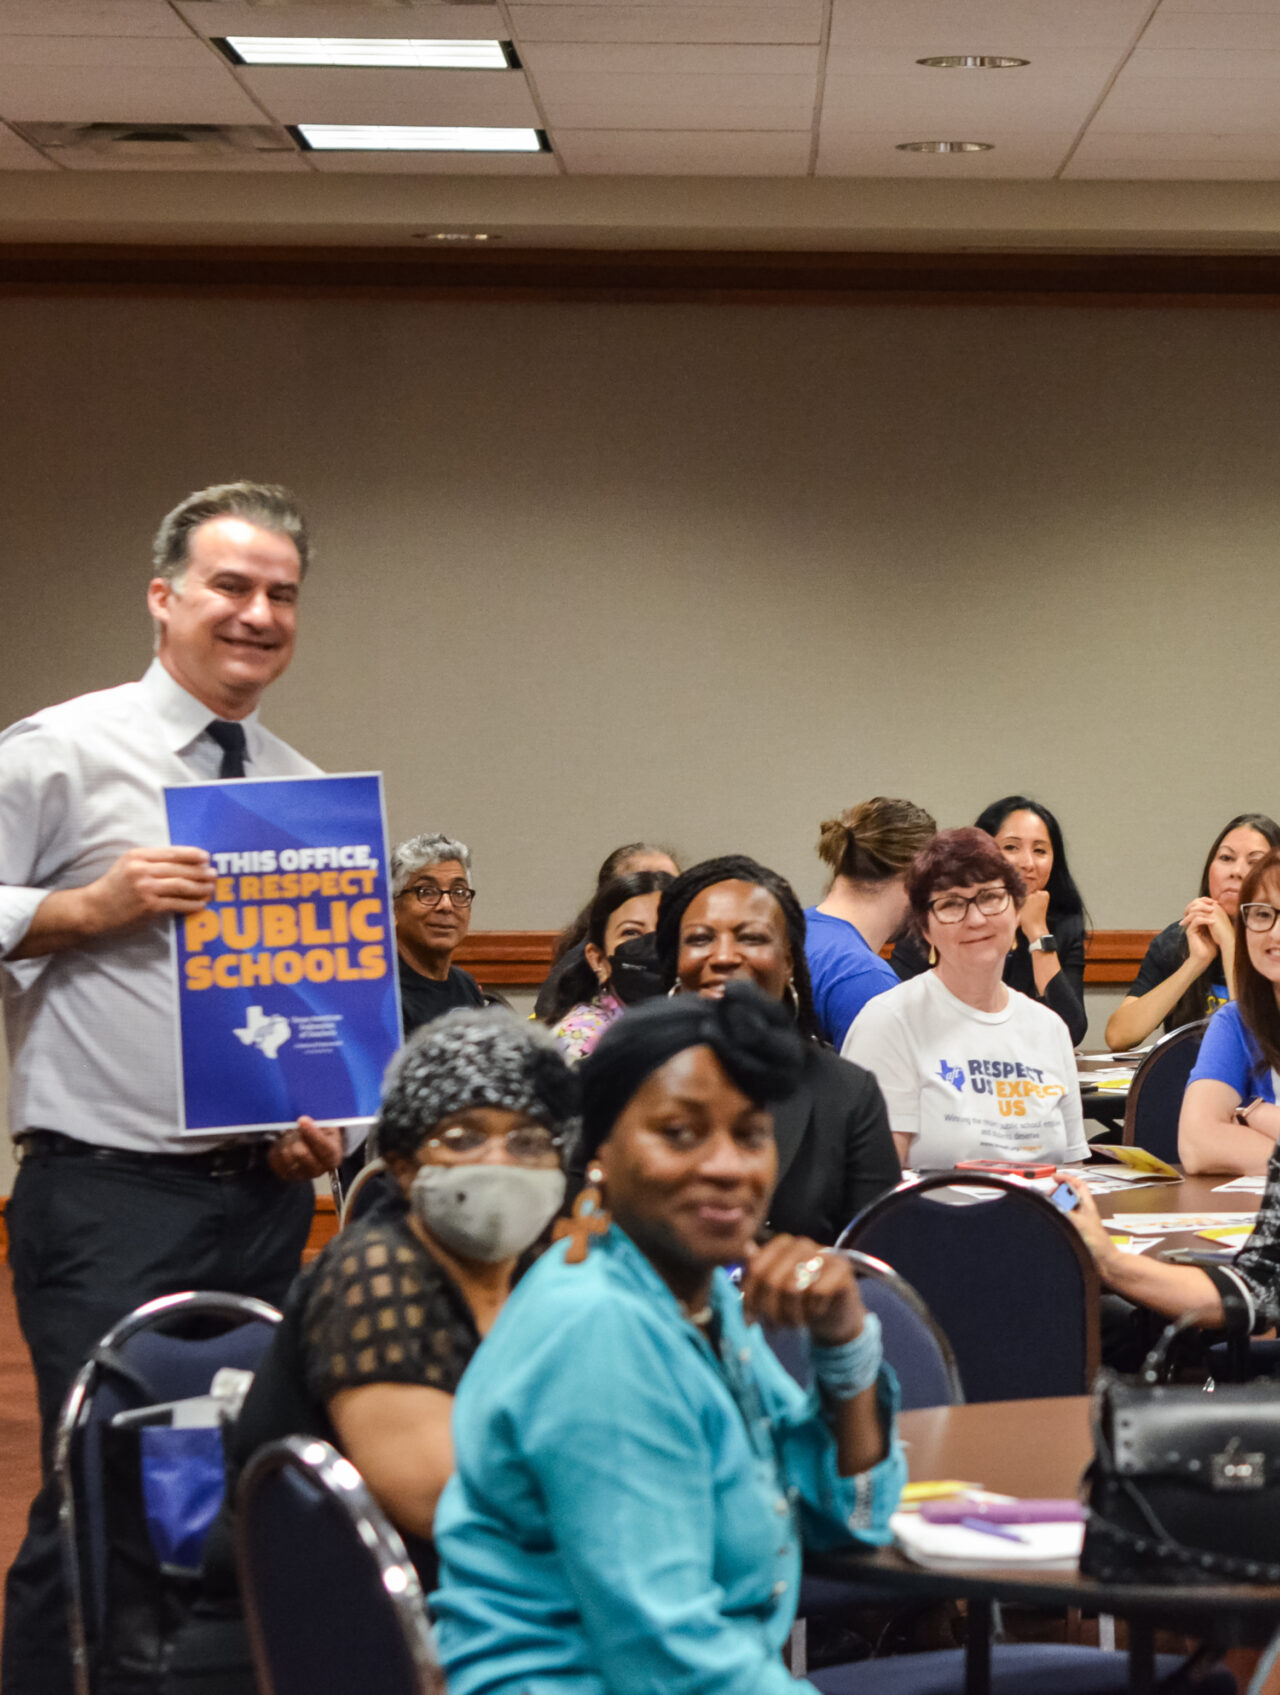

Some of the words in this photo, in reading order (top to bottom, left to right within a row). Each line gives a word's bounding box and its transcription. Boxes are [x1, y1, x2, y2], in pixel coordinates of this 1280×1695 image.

[213, 850, 277, 874] THIS
[279, 845, 379, 871] OFFICE,
[214, 877, 235, 902] E
[239, 869, 378, 900] RESPECT
[184, 898, 385, 953] PUBLIC
[184, 944, 387, 991] SCHOOLS
[968, 1059, 1044, 1084] RESPECT
[971, 1078, 994, 1096] US
[998, 1099, 1027, 1117] US
